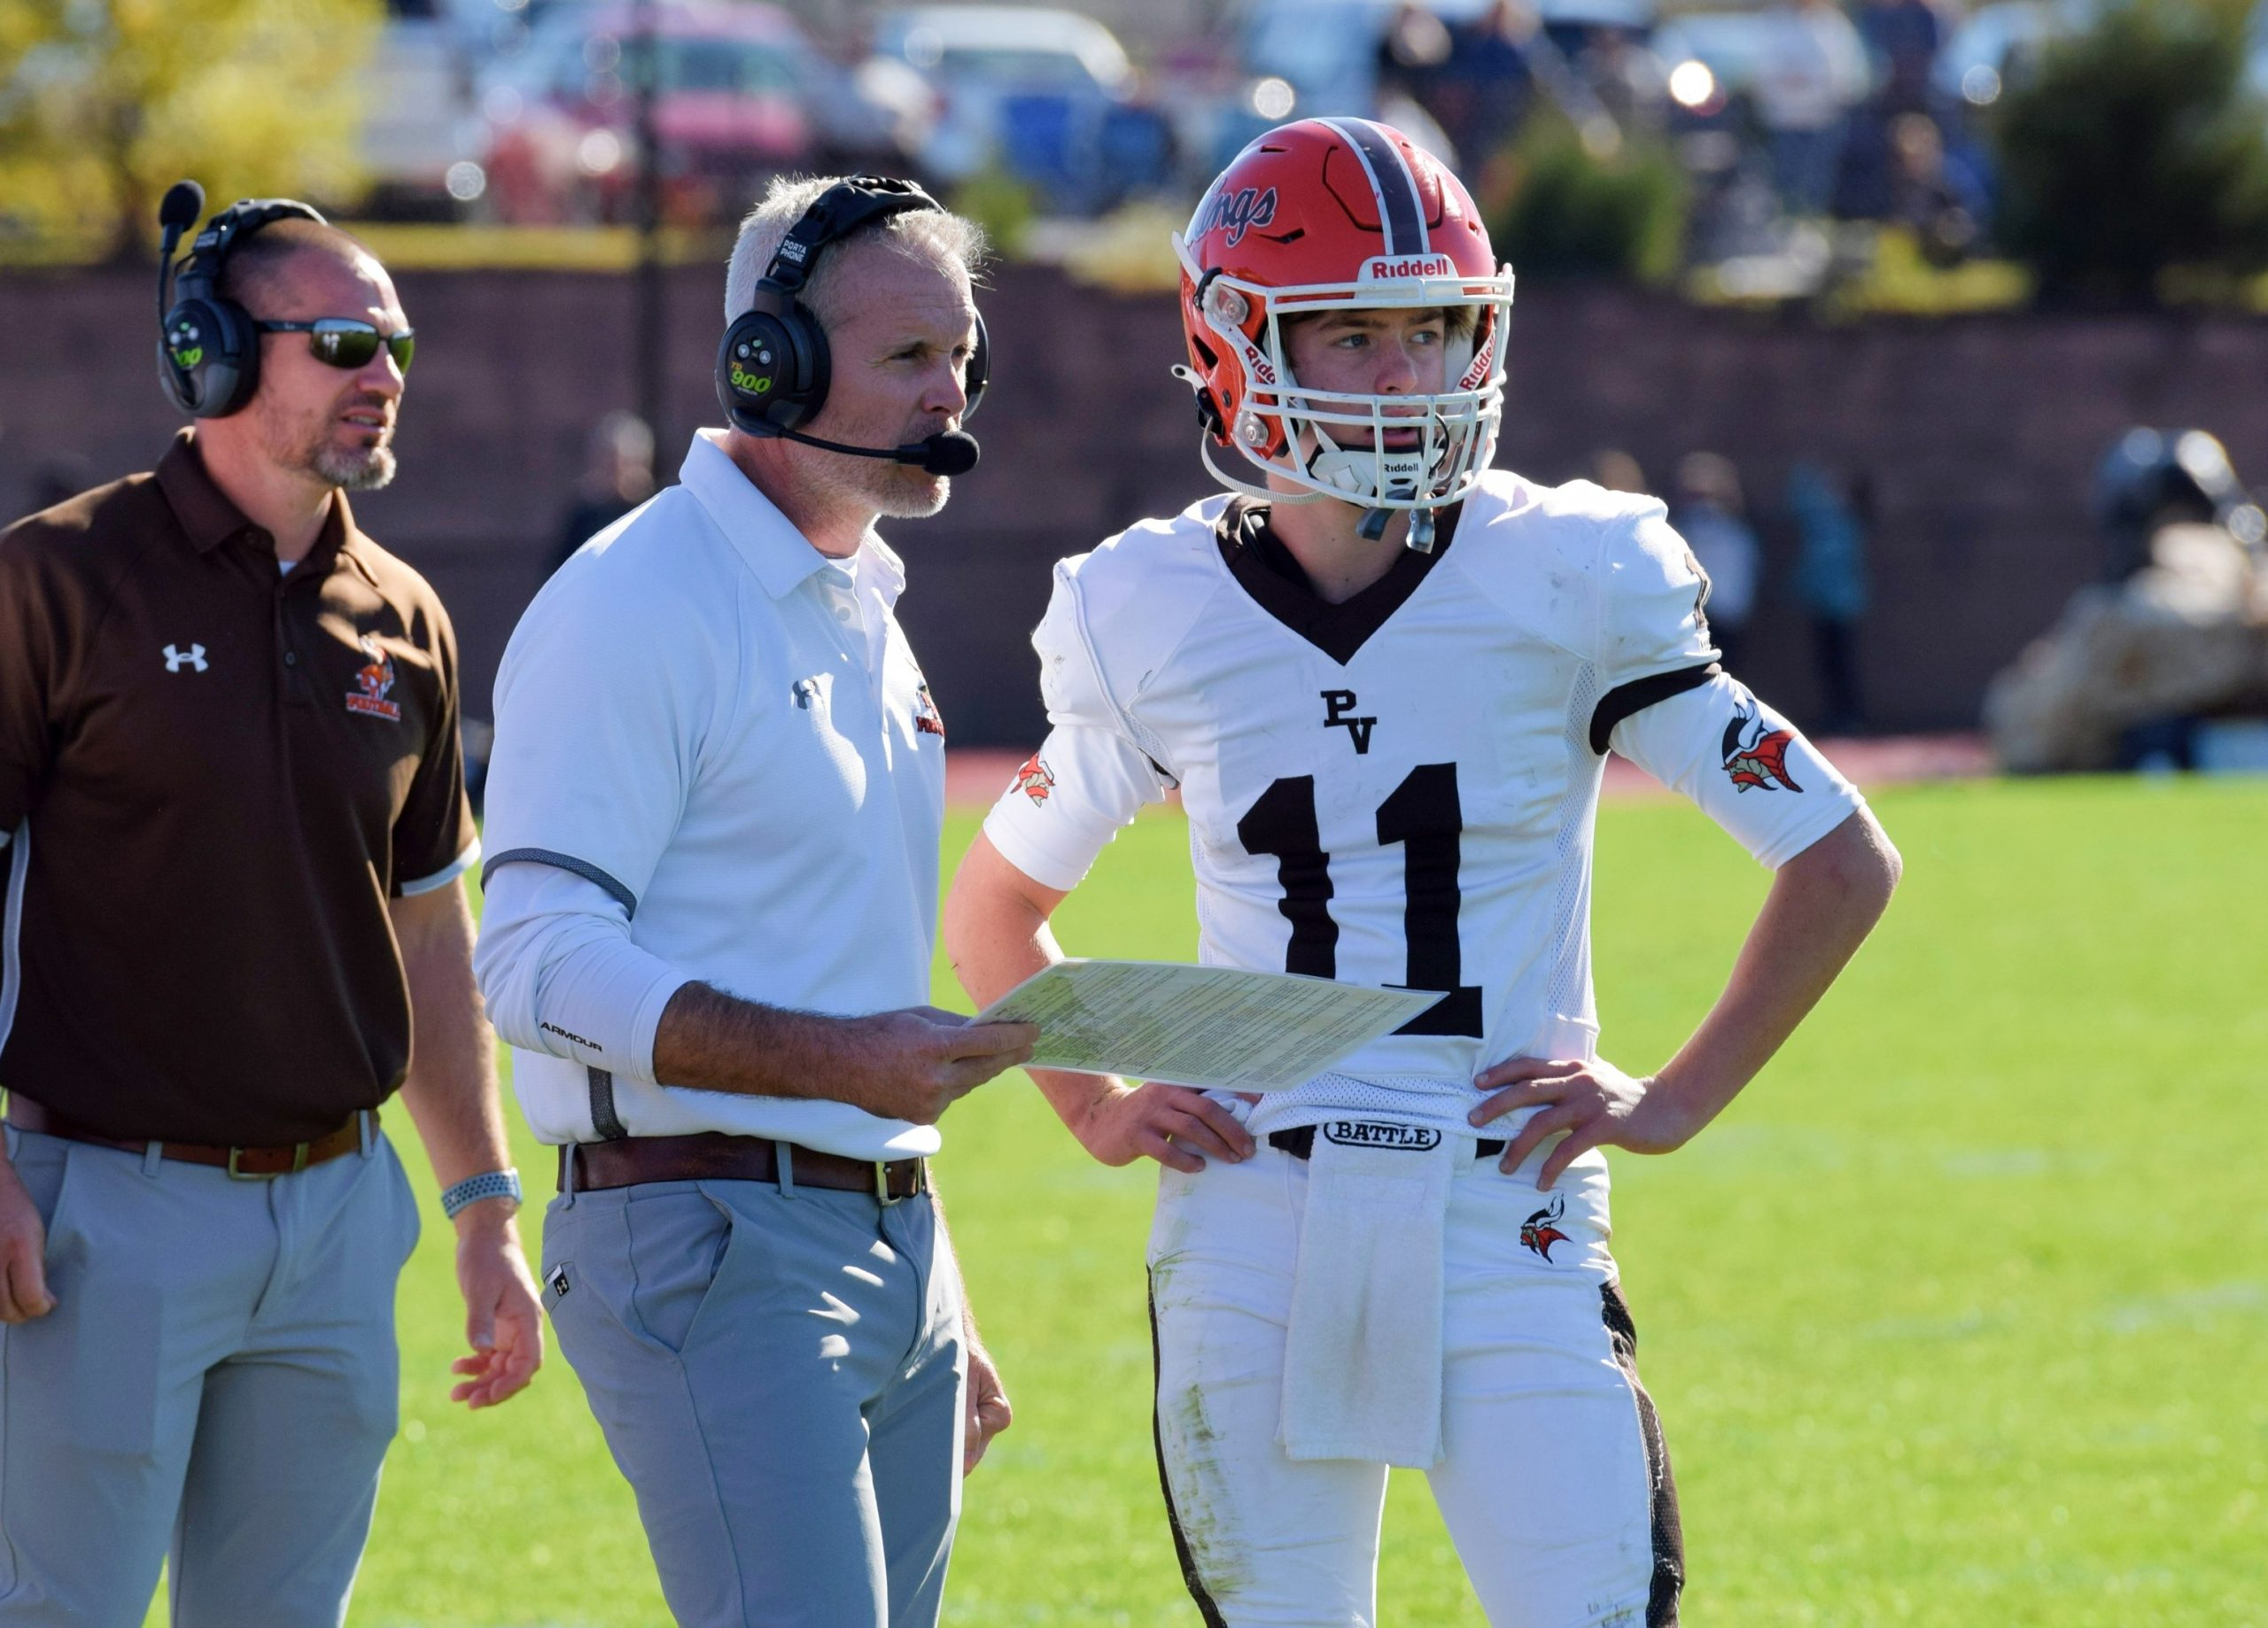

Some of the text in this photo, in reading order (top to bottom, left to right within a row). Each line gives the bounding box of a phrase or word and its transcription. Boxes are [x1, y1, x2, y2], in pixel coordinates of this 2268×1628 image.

[780, 247, 804, 263] PHONE
[783, 239, 807, 255] PORTA
[1371, 259, 1448, 279] Riddell
[731, 370, 772, 393] 900
[1384, 463, 1419, 473] Riddell
[1237, 762, 1484, 1038] 11
[540, 1021, 602, 1052] ARMOUR
[1333, 1121, 1430, 1145] BATTLE
